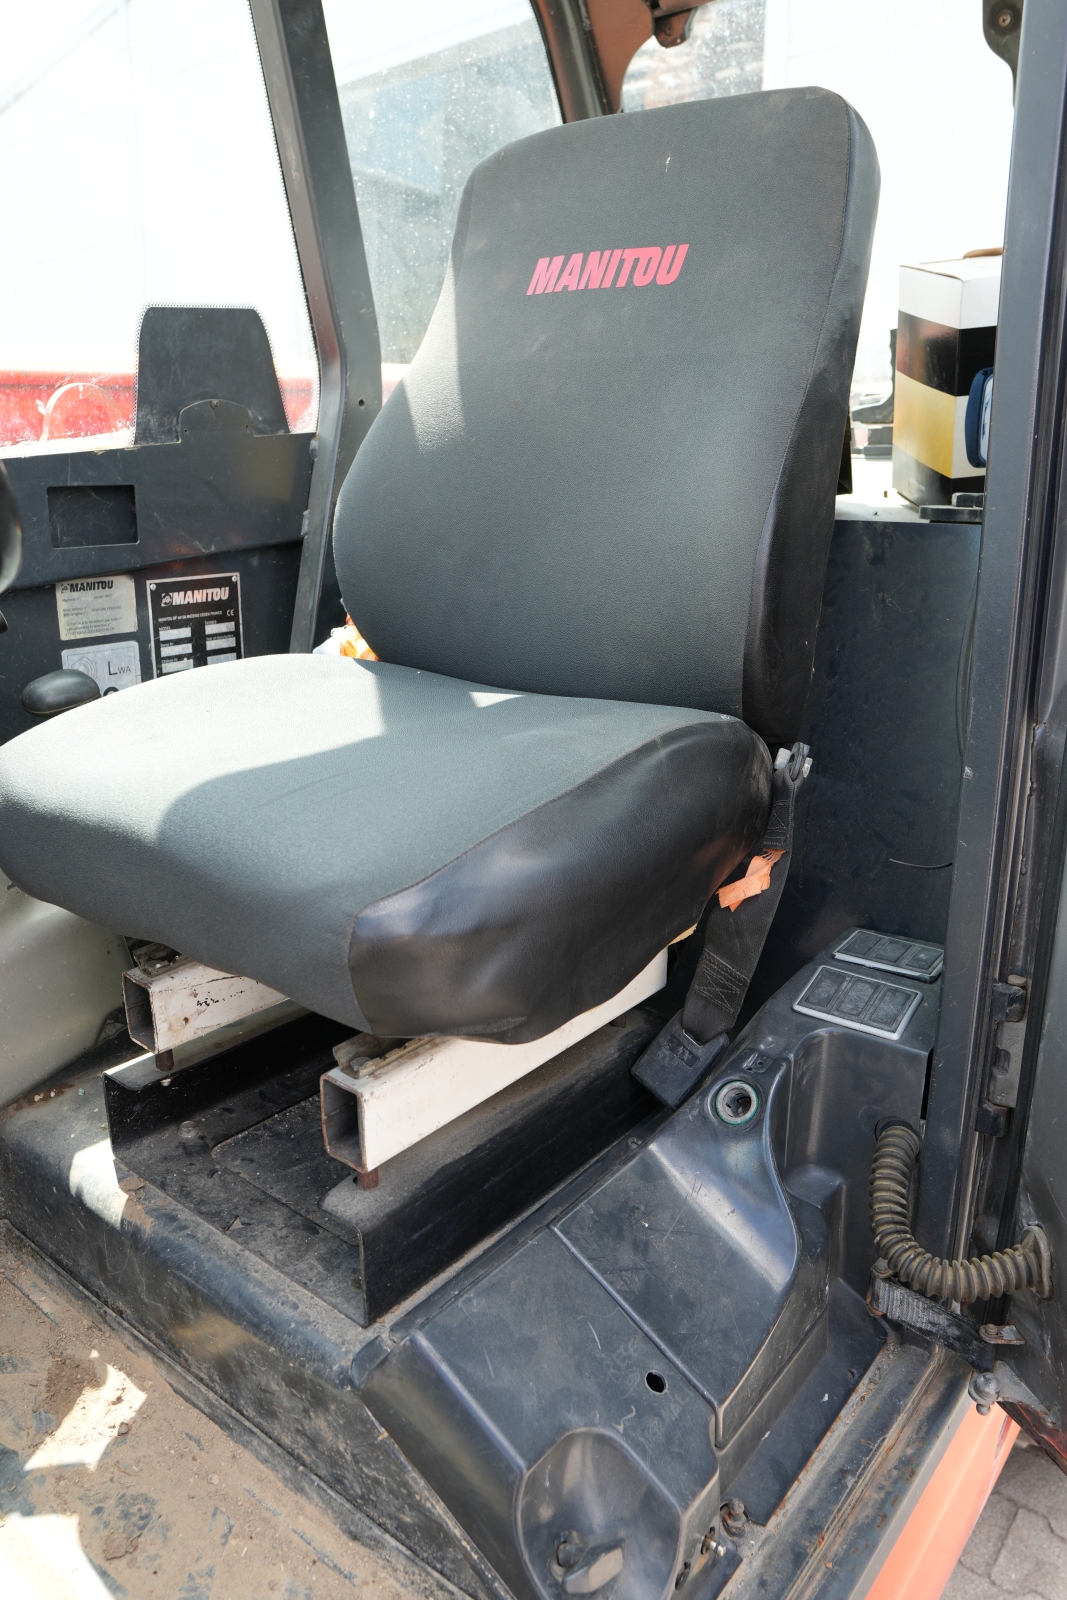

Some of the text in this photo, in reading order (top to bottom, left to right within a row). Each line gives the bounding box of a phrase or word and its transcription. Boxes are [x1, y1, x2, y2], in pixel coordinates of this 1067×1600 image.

[526, 244, 690, 295] MANITOU
[70, 580, 114, 592] MANITOU
[172, 586, 230, 606] MANITOU
